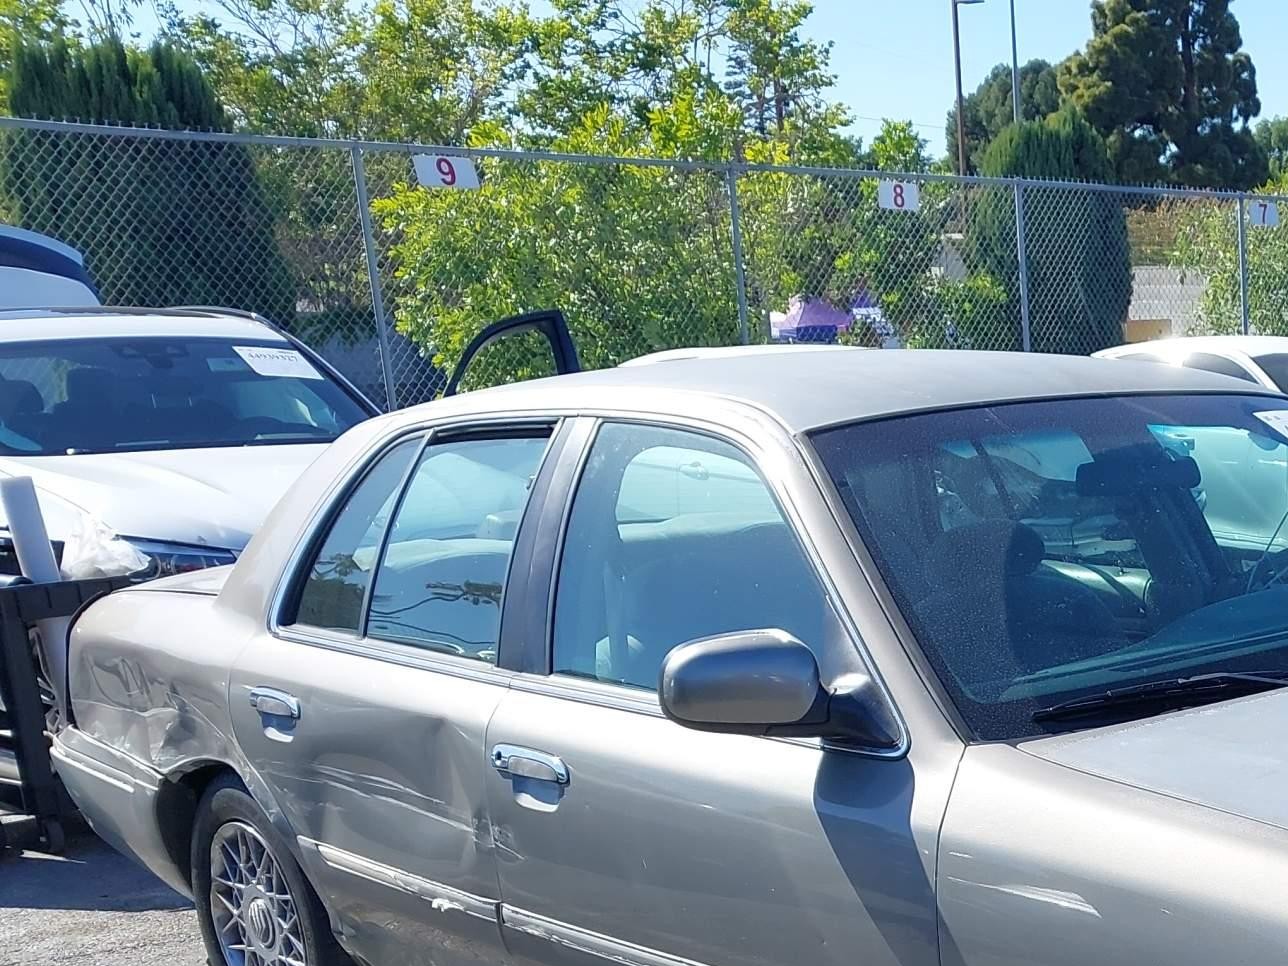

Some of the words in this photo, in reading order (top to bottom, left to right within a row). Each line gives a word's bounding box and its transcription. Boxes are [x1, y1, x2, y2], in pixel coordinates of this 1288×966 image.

[436, 158, 456, 185] 9
[893, 184, 904, 207] 8
[1259, 203, 1267, 224] 7
